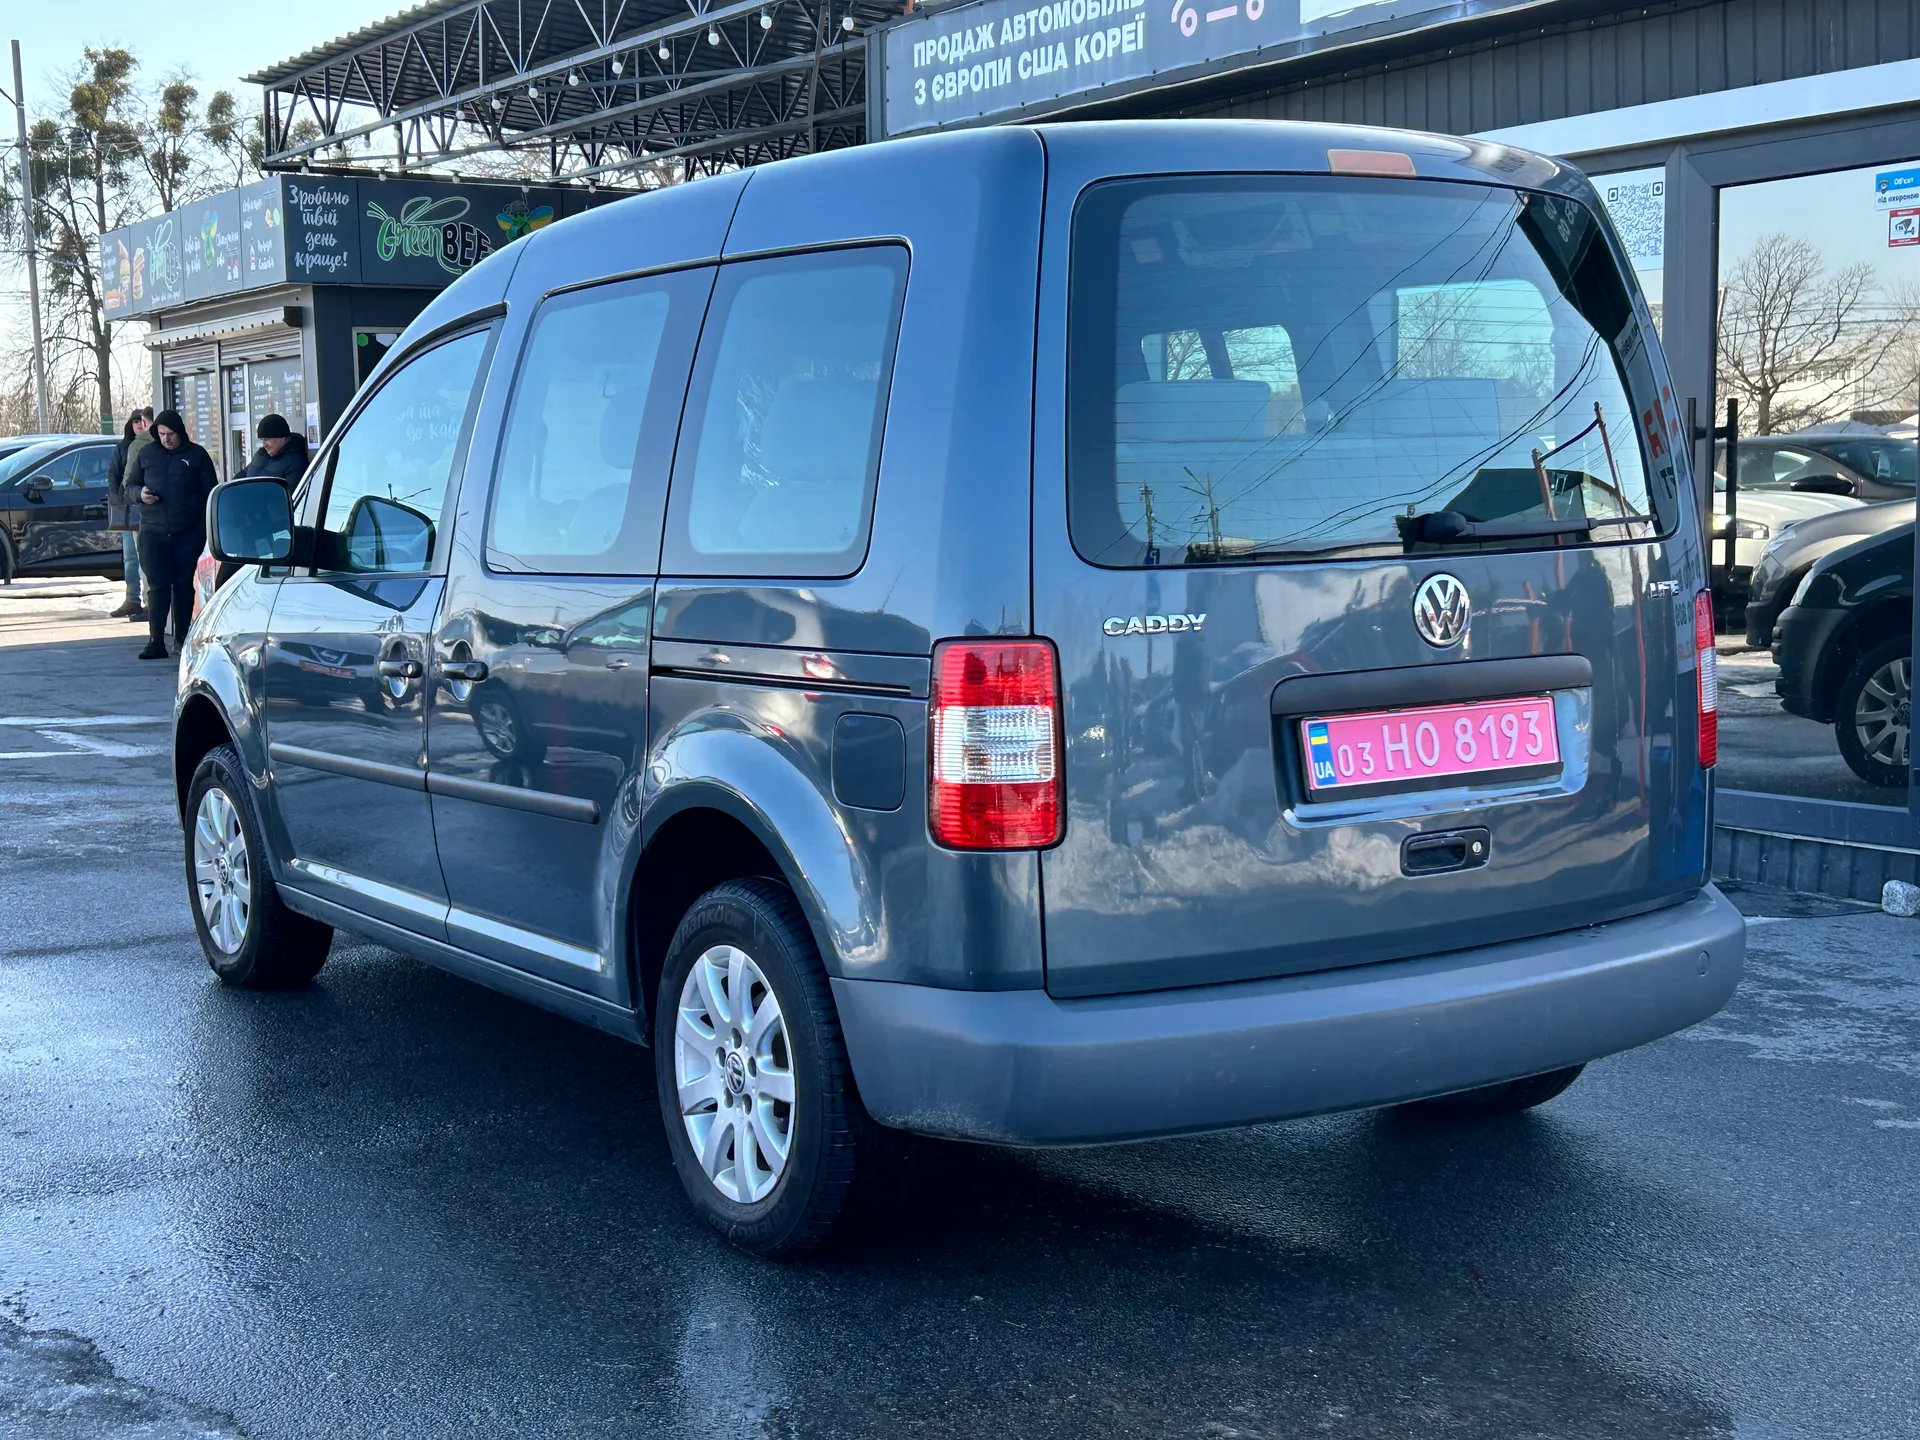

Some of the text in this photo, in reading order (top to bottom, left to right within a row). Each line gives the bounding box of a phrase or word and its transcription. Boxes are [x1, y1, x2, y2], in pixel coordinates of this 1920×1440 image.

[914, 0, 1146, 68] ПРОДАЖ АВТОМОБІЛ
[914, 12, 1145, 105] З ЄВРОПИ США КОРЕЇ
[289, 185, 349, 211] Зробимо
[303, 206, 338, 226] твій
[305, 231, 338, 251] день
[294, 251, 348, 274] краще!
[1103, 613, 1206, 636] CADDY
[1337, 741, 1375, 777] 03
[1453, 710, 1543, 763] 8193
[1314, 760, 1336, 779] UA
